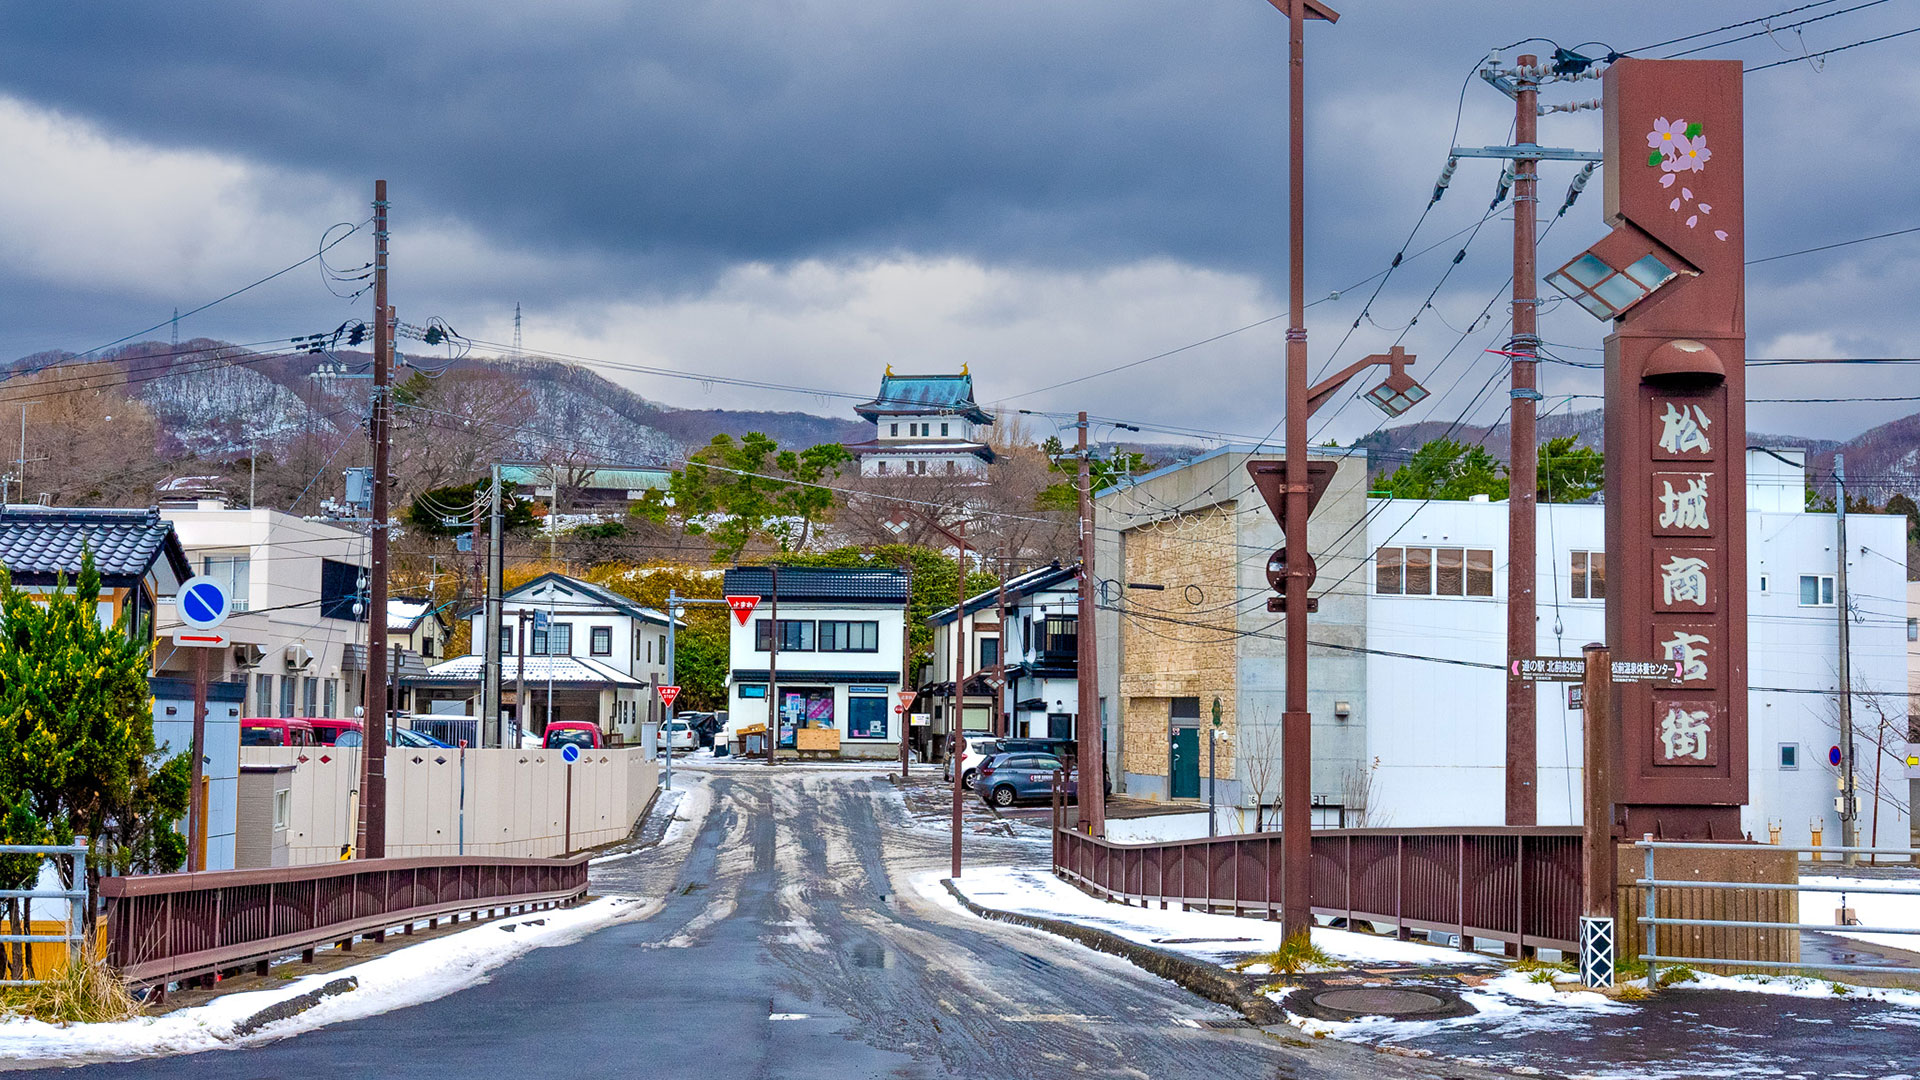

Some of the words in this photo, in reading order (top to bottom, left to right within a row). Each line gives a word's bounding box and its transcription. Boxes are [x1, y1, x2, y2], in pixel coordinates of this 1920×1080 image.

[1660, 402, 1711, 760] 松城商店街
[1522, 659, 1545, 673] 道の駅
[1611, 662, 1675, 675] 松前温泉休養センター
